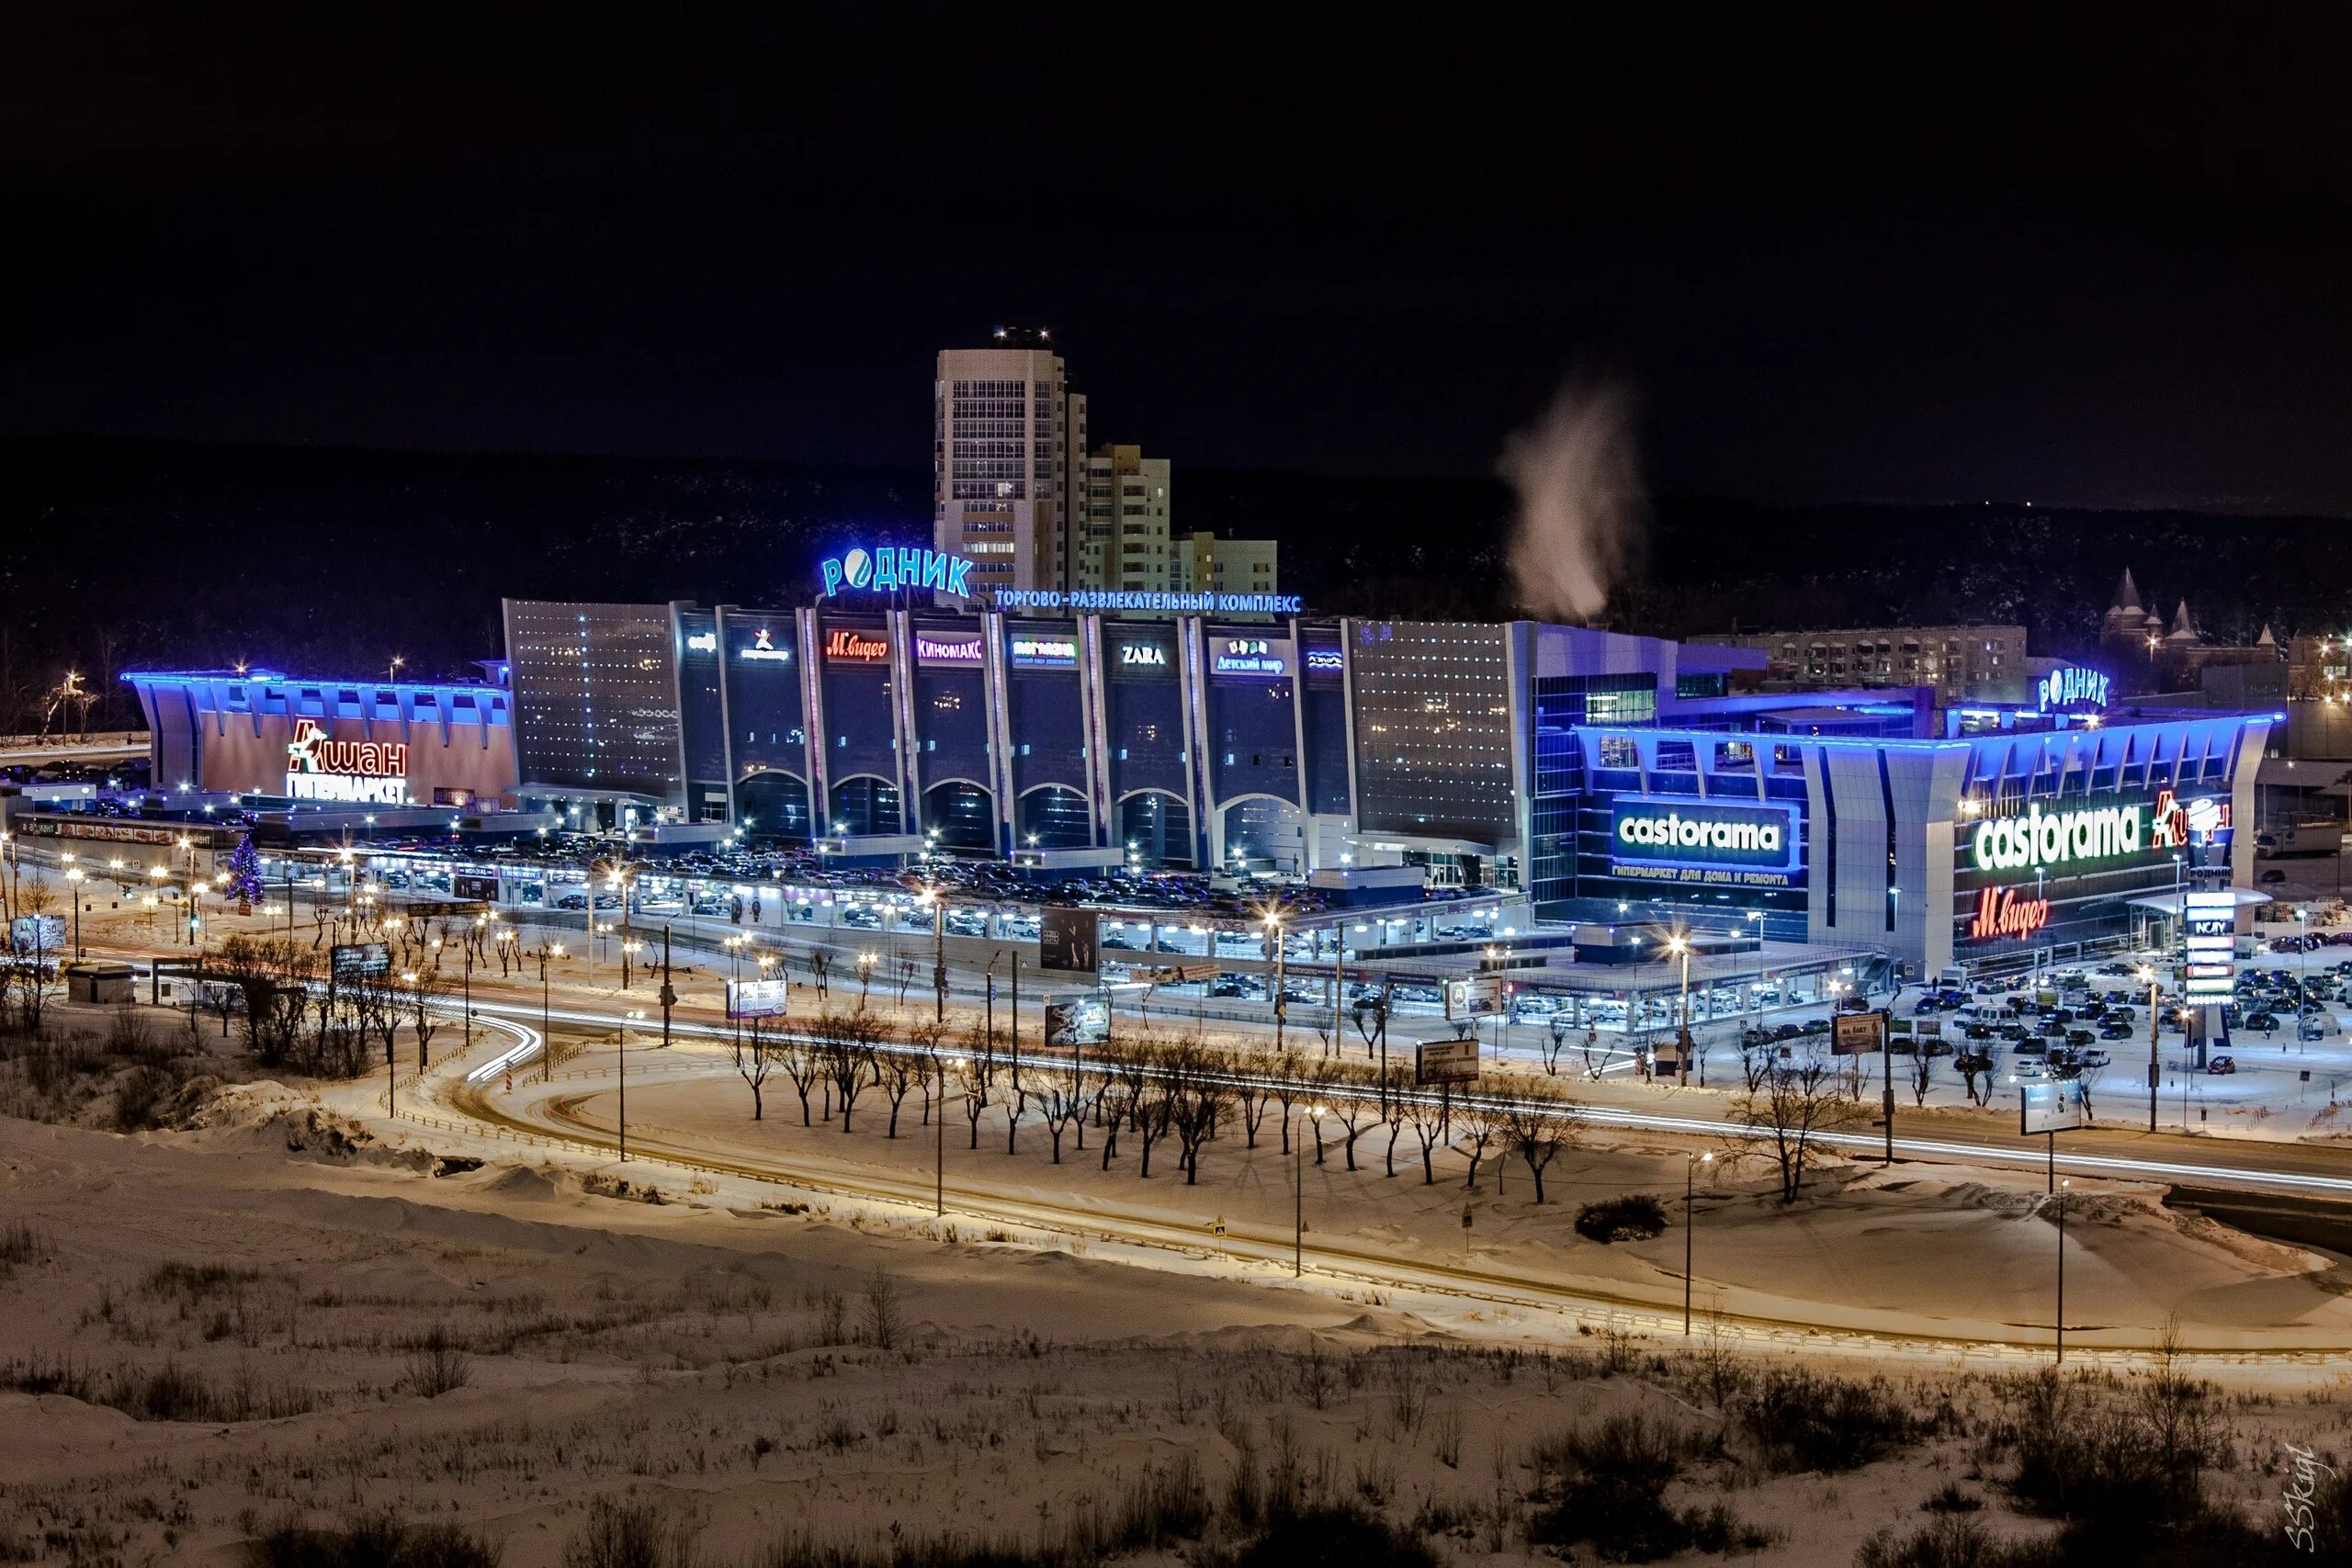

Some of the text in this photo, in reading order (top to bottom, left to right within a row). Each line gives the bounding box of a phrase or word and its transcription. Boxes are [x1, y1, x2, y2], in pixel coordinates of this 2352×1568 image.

[822, 547, 974, 598] РОДНИК
[994, 590, 1302, 613] ТОРГОВО-РАЗВЛЕКАТЕЛЬНЫЙ КОМПЛЕКС
[827, 631, 888, 661] М.видео
[917, 637, 982, 660] КИНОМАКС
[1123, 646, 1165, 665] ZARA
[1217, 656, 1283, 675] Детский мир
[2038, 667, 2110, 713] РОДНИК
[286, 773, 406, 805] ГИПЕРМАРКЕТ
[1619, 813, 1781, 852] castorama
[1975, 802, 2140, 872] castorama
[1611, 864, 1789, 886] ГИПЕРМАРКЕТ ДЛЯ ДОМА И РЕМОНТА
[2189, 869, 2232, 879] РОДНИК
[1973, 886, 2049, 941] М.видео
